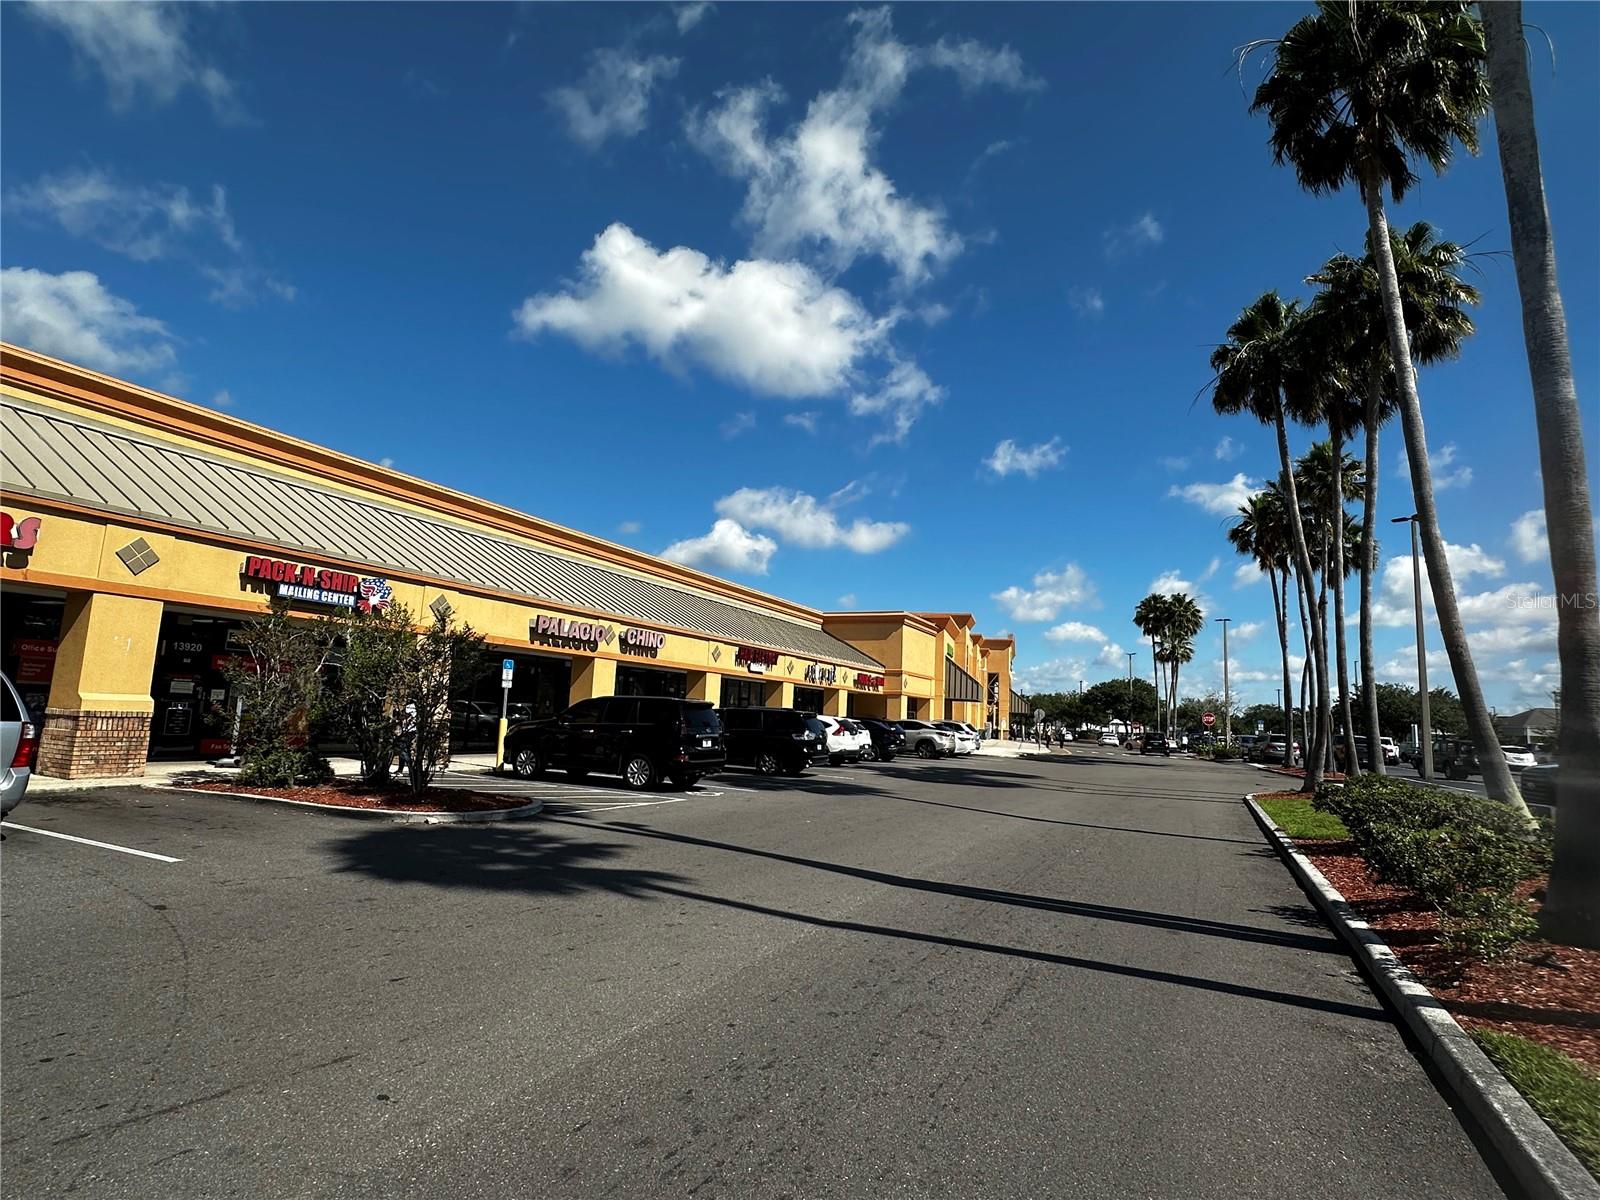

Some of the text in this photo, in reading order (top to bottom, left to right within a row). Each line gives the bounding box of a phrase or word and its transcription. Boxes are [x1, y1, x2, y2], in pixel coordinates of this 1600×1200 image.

[247, 556, 359, 592] PACK-N-SHIP
[278, 583, 355, 605] MAILING CENTER
[537, 615, 666, 649] PALACIO CHINO
[172, 641, 203, 652] 13920
